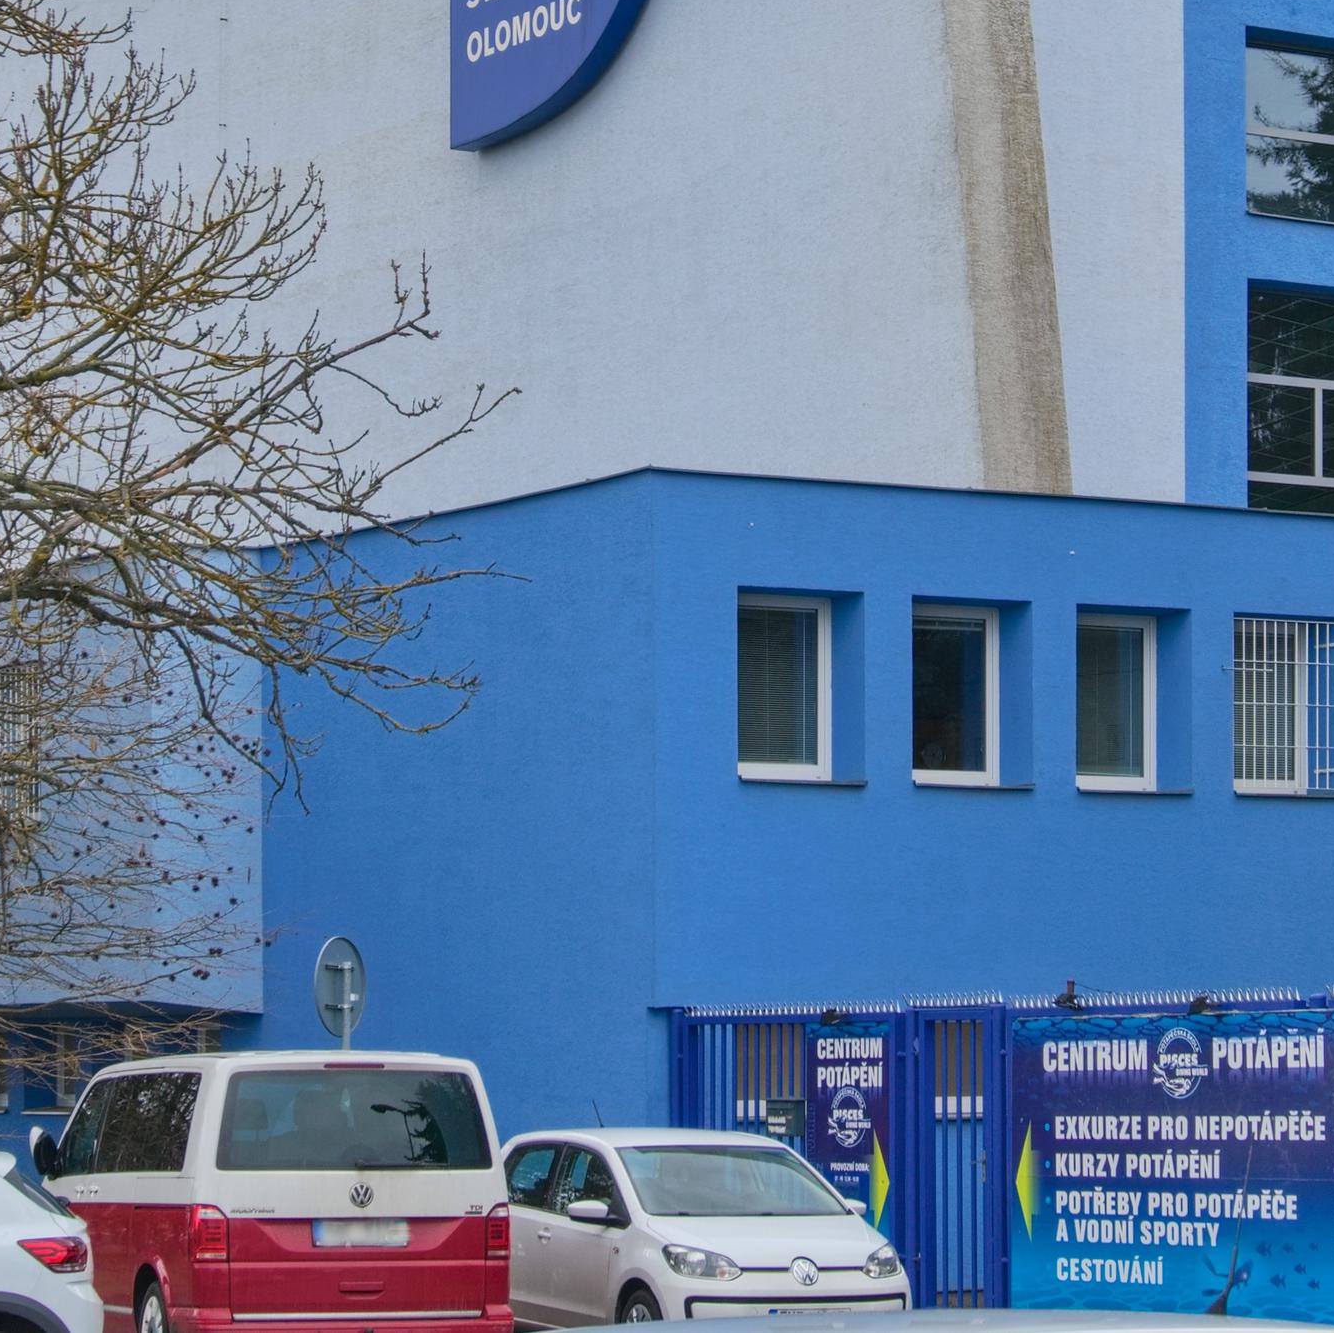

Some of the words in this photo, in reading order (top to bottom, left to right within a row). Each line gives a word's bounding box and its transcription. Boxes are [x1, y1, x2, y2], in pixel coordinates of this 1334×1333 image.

[817, 1037, 883, 1059] CENTRUM
[1042, 1039, 1148, 1073] CENTRUM
[1212, 1028, 1325, 1070] POTÁPĚNÍ
[1159, 1053, 1199, 1068] PISCES
[817, 1062, 883, 1088] POTÁPĚNÍ
[1055, 1116, 1142, 1140] EXKURZE
[1147, 1116, 1189, 1140] PRO
[1195, 1110, 1326, 1141] NEPOTÁPĚČE
[1055, 1153, 1120, 1178] KURZY
[1125, 1149, 1221, 1179] POTÁPĚNÍ
[1055, 1186, 1142, 1215] POTŘEBY
[1148, 1192, 1189, 1217] PRO
[1194, 1189, 1298, 1220] POTÁPĚČE
[1056, 1219, 1069, 1242] A
[1073, 1215, 1135, 1244] VODNÍ
[1139, 1221, 1220, 1247] SPORTY
[1056, 1255, 1164, 1285] CESTOVÁNÍ
